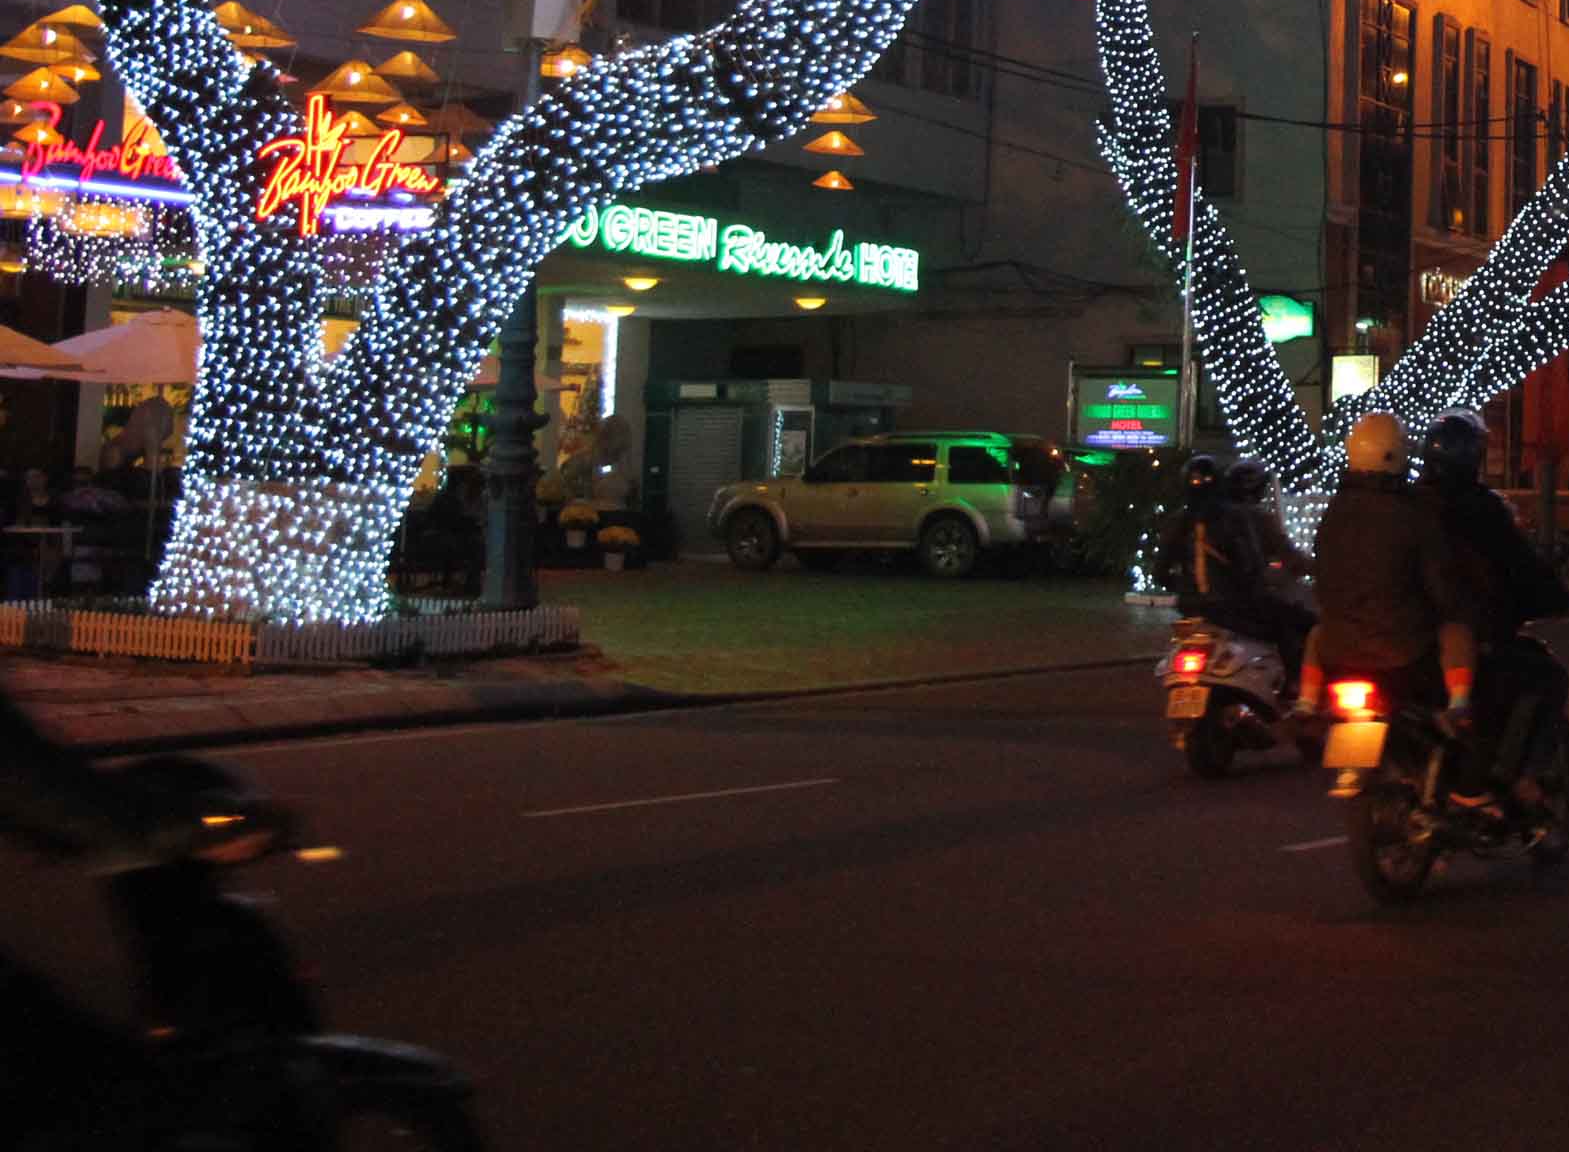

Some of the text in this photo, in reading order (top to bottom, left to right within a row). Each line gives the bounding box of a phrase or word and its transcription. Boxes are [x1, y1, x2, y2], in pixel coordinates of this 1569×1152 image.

[119, 118, 180, 182] Gree
[257, 129, 440, 217] Bamboo Green
[602, 204, 718, 261] GREEN
[856, 242, 919, 291] HOTEL
